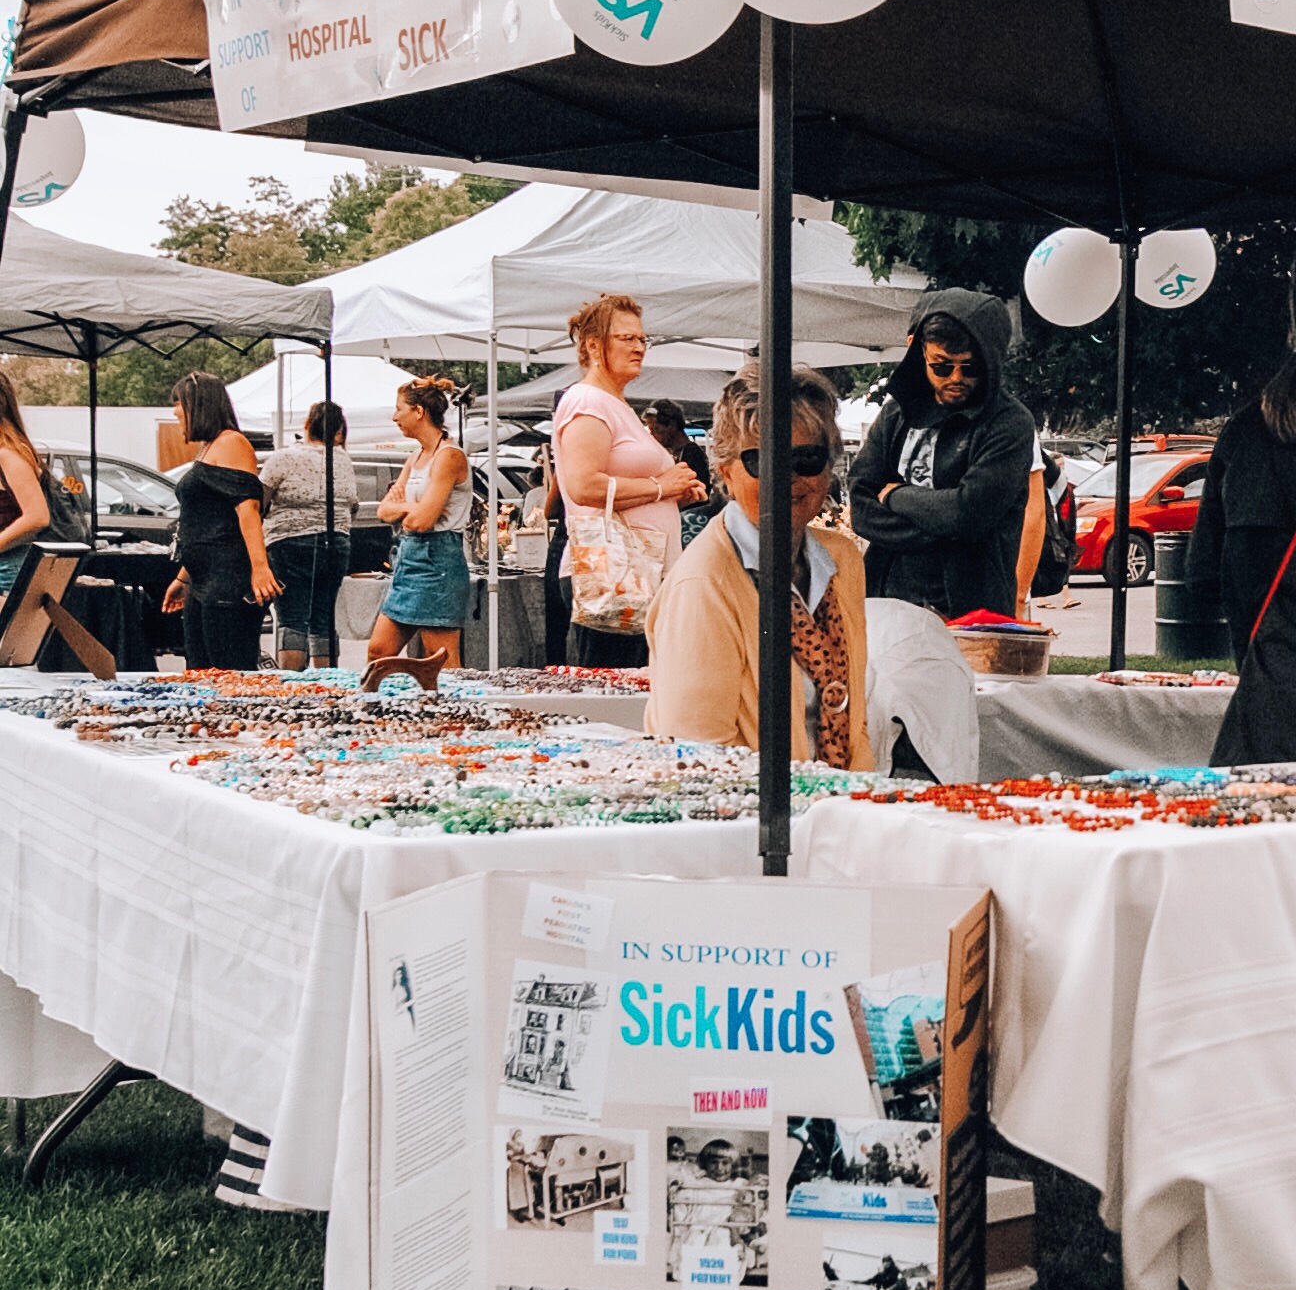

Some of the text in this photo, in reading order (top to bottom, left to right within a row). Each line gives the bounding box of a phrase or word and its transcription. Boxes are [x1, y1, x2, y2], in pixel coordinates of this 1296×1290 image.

[288, 14, 372, 62] HOSPITAL
[594, 10, 630, 42] SickKids
[218, 30, 271, 69] SUPPORT
[398, 18, 450, 71] SICK
[241, 86, 257, 113] OF
[621, 941, 838, 969] IN SUPPORT OF
[619, 980, 836, 1055] SickKids
[693, 1087, 768, 1114] THEN AND NOW
